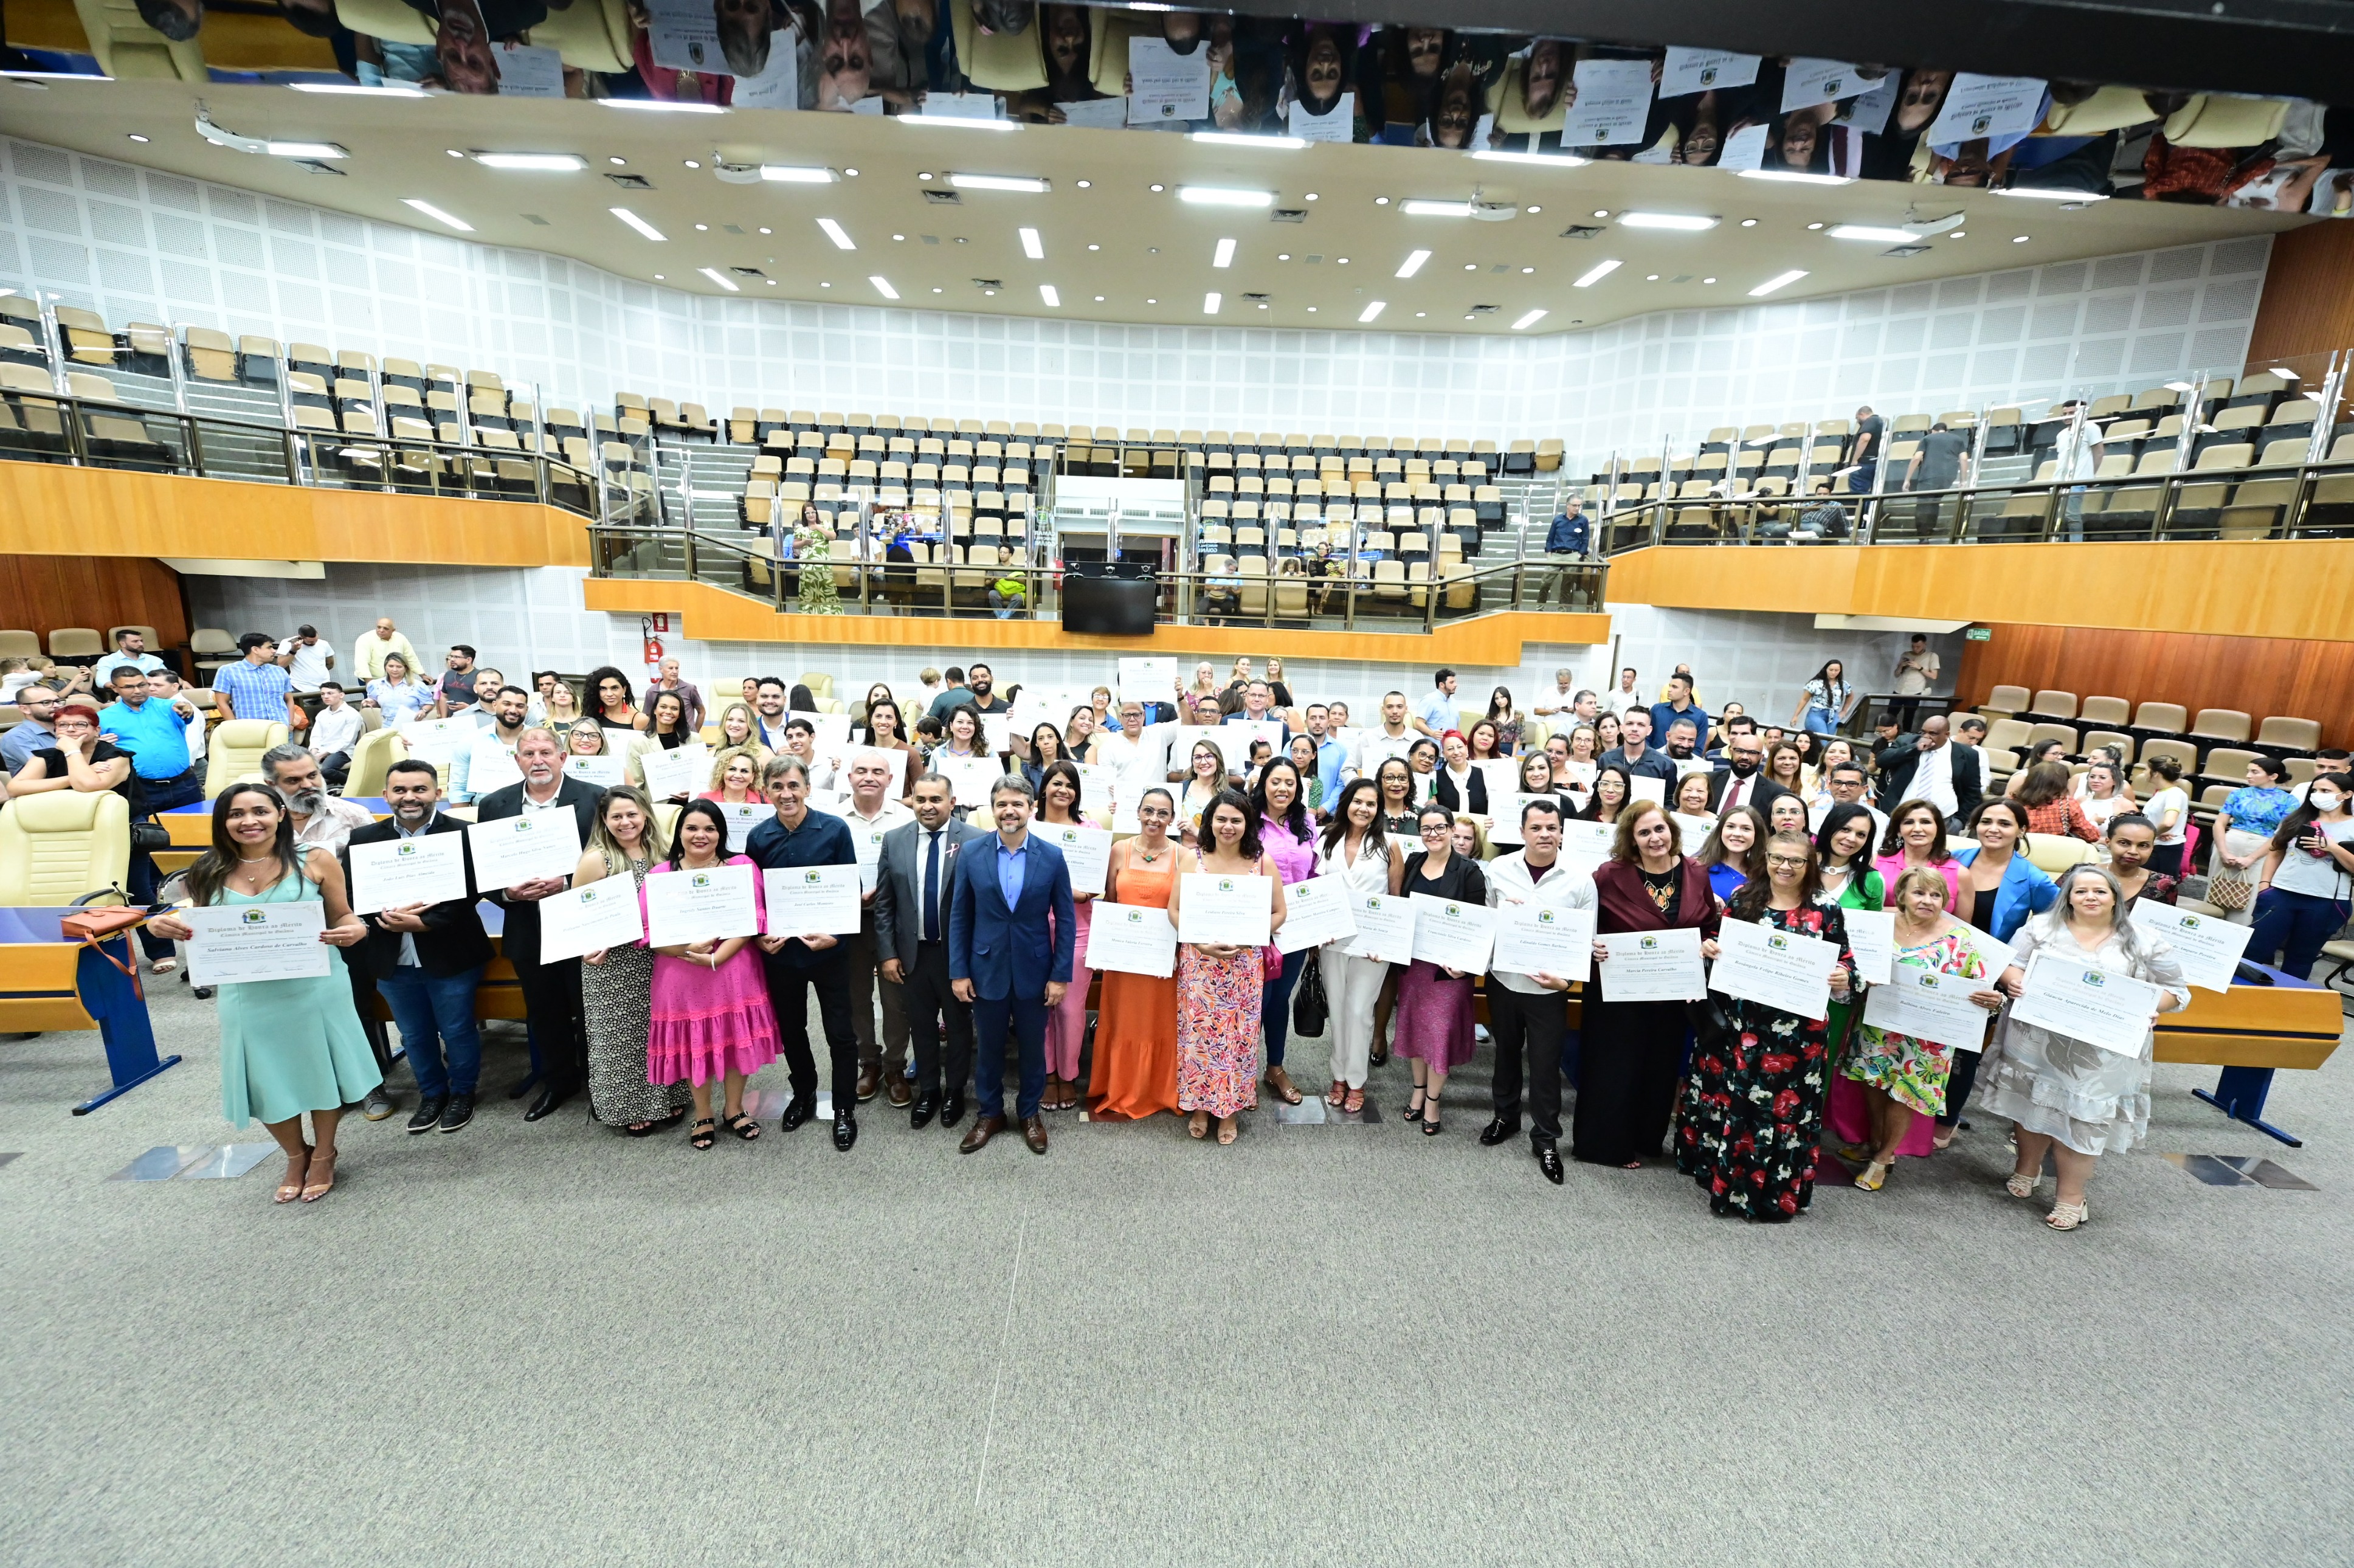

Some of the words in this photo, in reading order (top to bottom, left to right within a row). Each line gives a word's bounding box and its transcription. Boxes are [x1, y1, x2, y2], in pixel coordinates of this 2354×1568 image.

[2148, 919, 2171, 928] Diploma
[2206, 936, 2225, 945] Mérito
[1738, 941, 1761, 951] Diploma
[1769, 948, 1787, 958] Honra
[1797, 956, 1815, 965] Mérito
[2198, 951, 2216, 960] Pereira
[1775, 970, 1792, 979] Ribeiro
[1793, 975, 1809, 984] Gomes
[2065, 998, 2090, 1009] Aparecida
[2099, 1008, 2111, 1017] Melo
